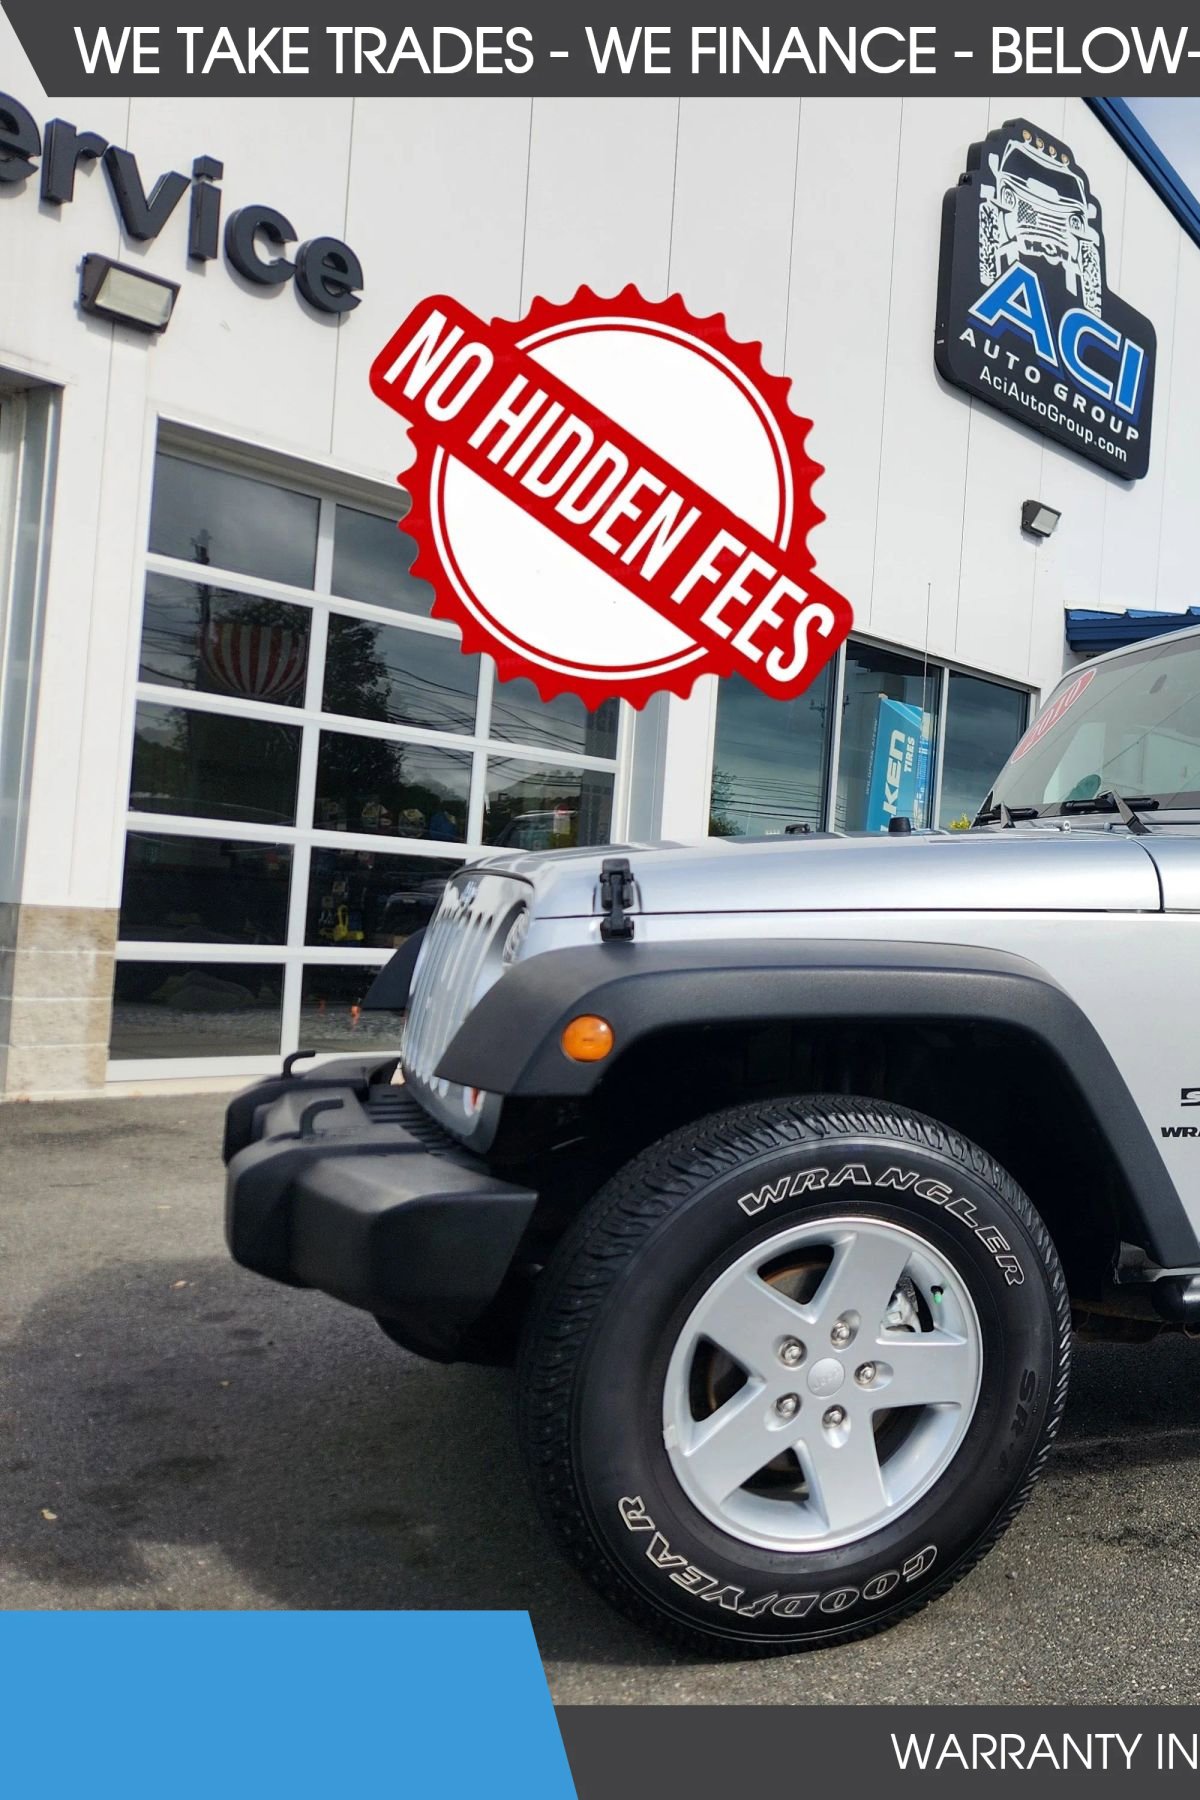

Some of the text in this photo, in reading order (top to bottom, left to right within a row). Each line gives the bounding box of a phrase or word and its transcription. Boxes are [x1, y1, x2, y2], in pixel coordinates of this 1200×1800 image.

[959, 327, 1139, 441] AUTO GROUP
[967, 260, 1145, 415] ACI
[979, 365, 1127, 463] AciAutoGroup.com
[903, 735, 915, 773] TIRES
[738, 1163, 1025, 1287] WRANGLER
[617, 1495, 938, 1618] GOODYEAR
